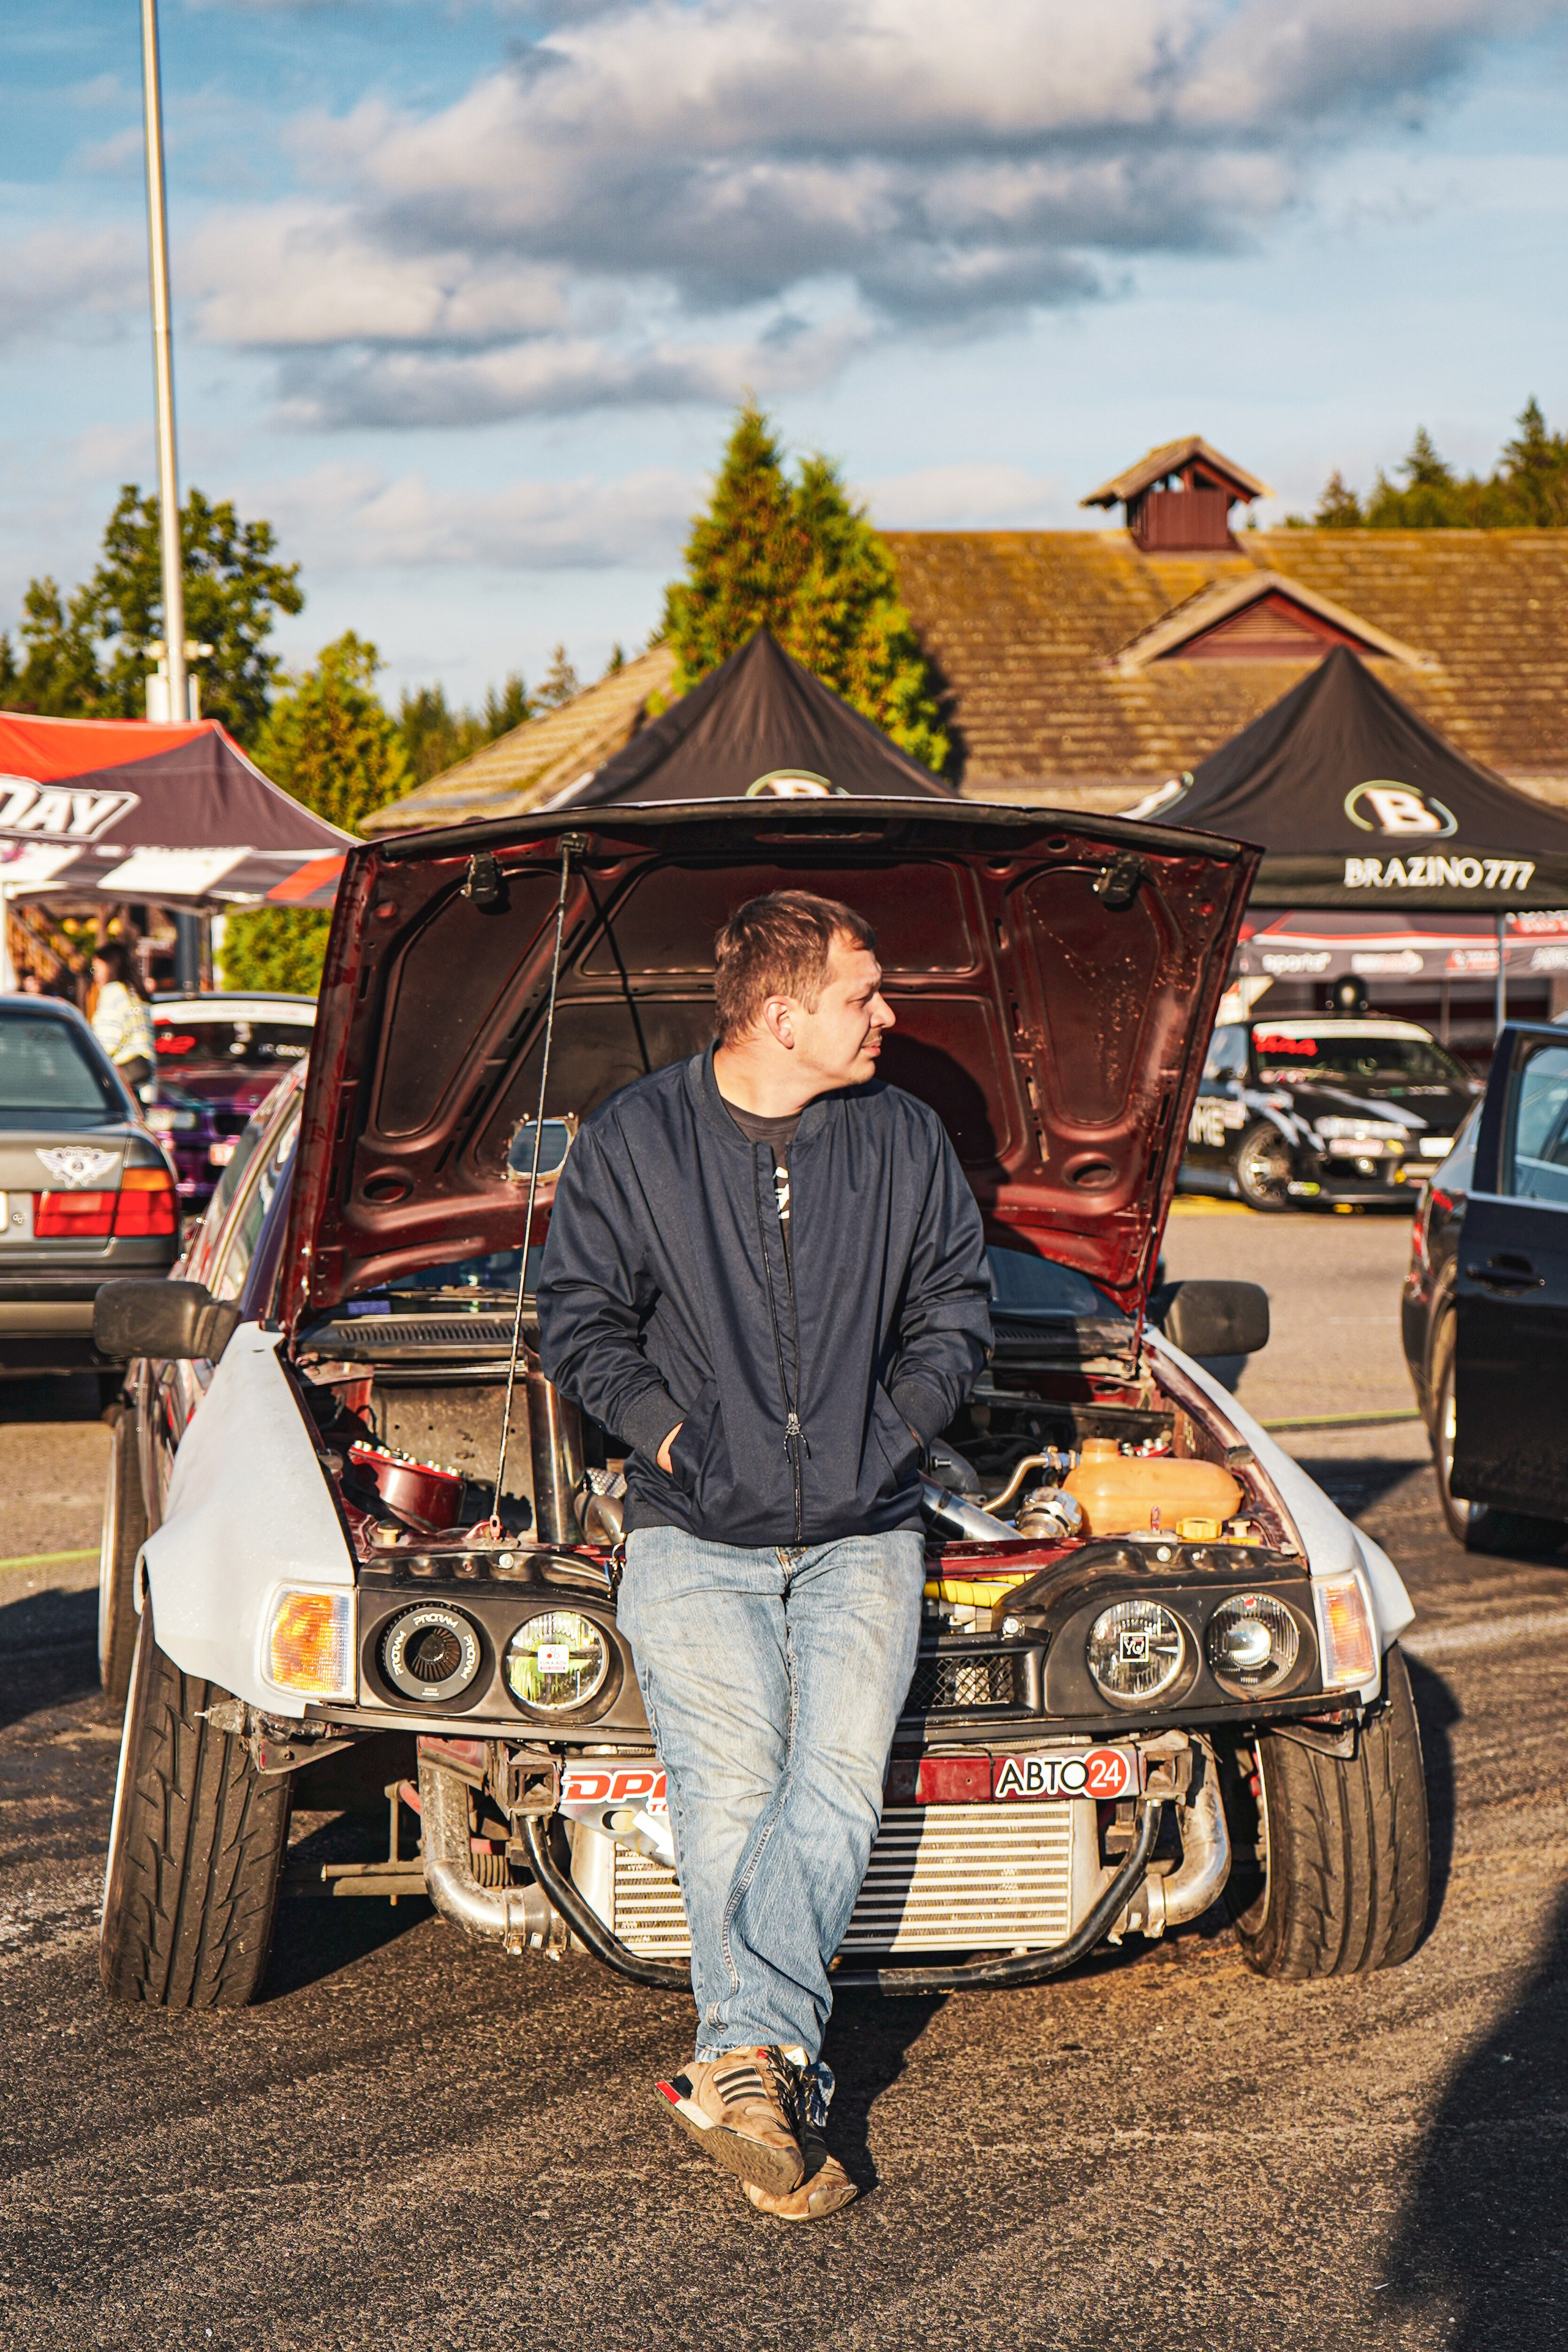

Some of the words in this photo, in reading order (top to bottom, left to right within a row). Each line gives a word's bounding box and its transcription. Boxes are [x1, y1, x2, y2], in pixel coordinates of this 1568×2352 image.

[1343, 856, 1536, 891] BRAZINO777
[413, 1613, 459, 1628] PRORAM
[391, 1630, 407, 1676] PRORAM
[460, 1634, 476, 1680] PRORAM
